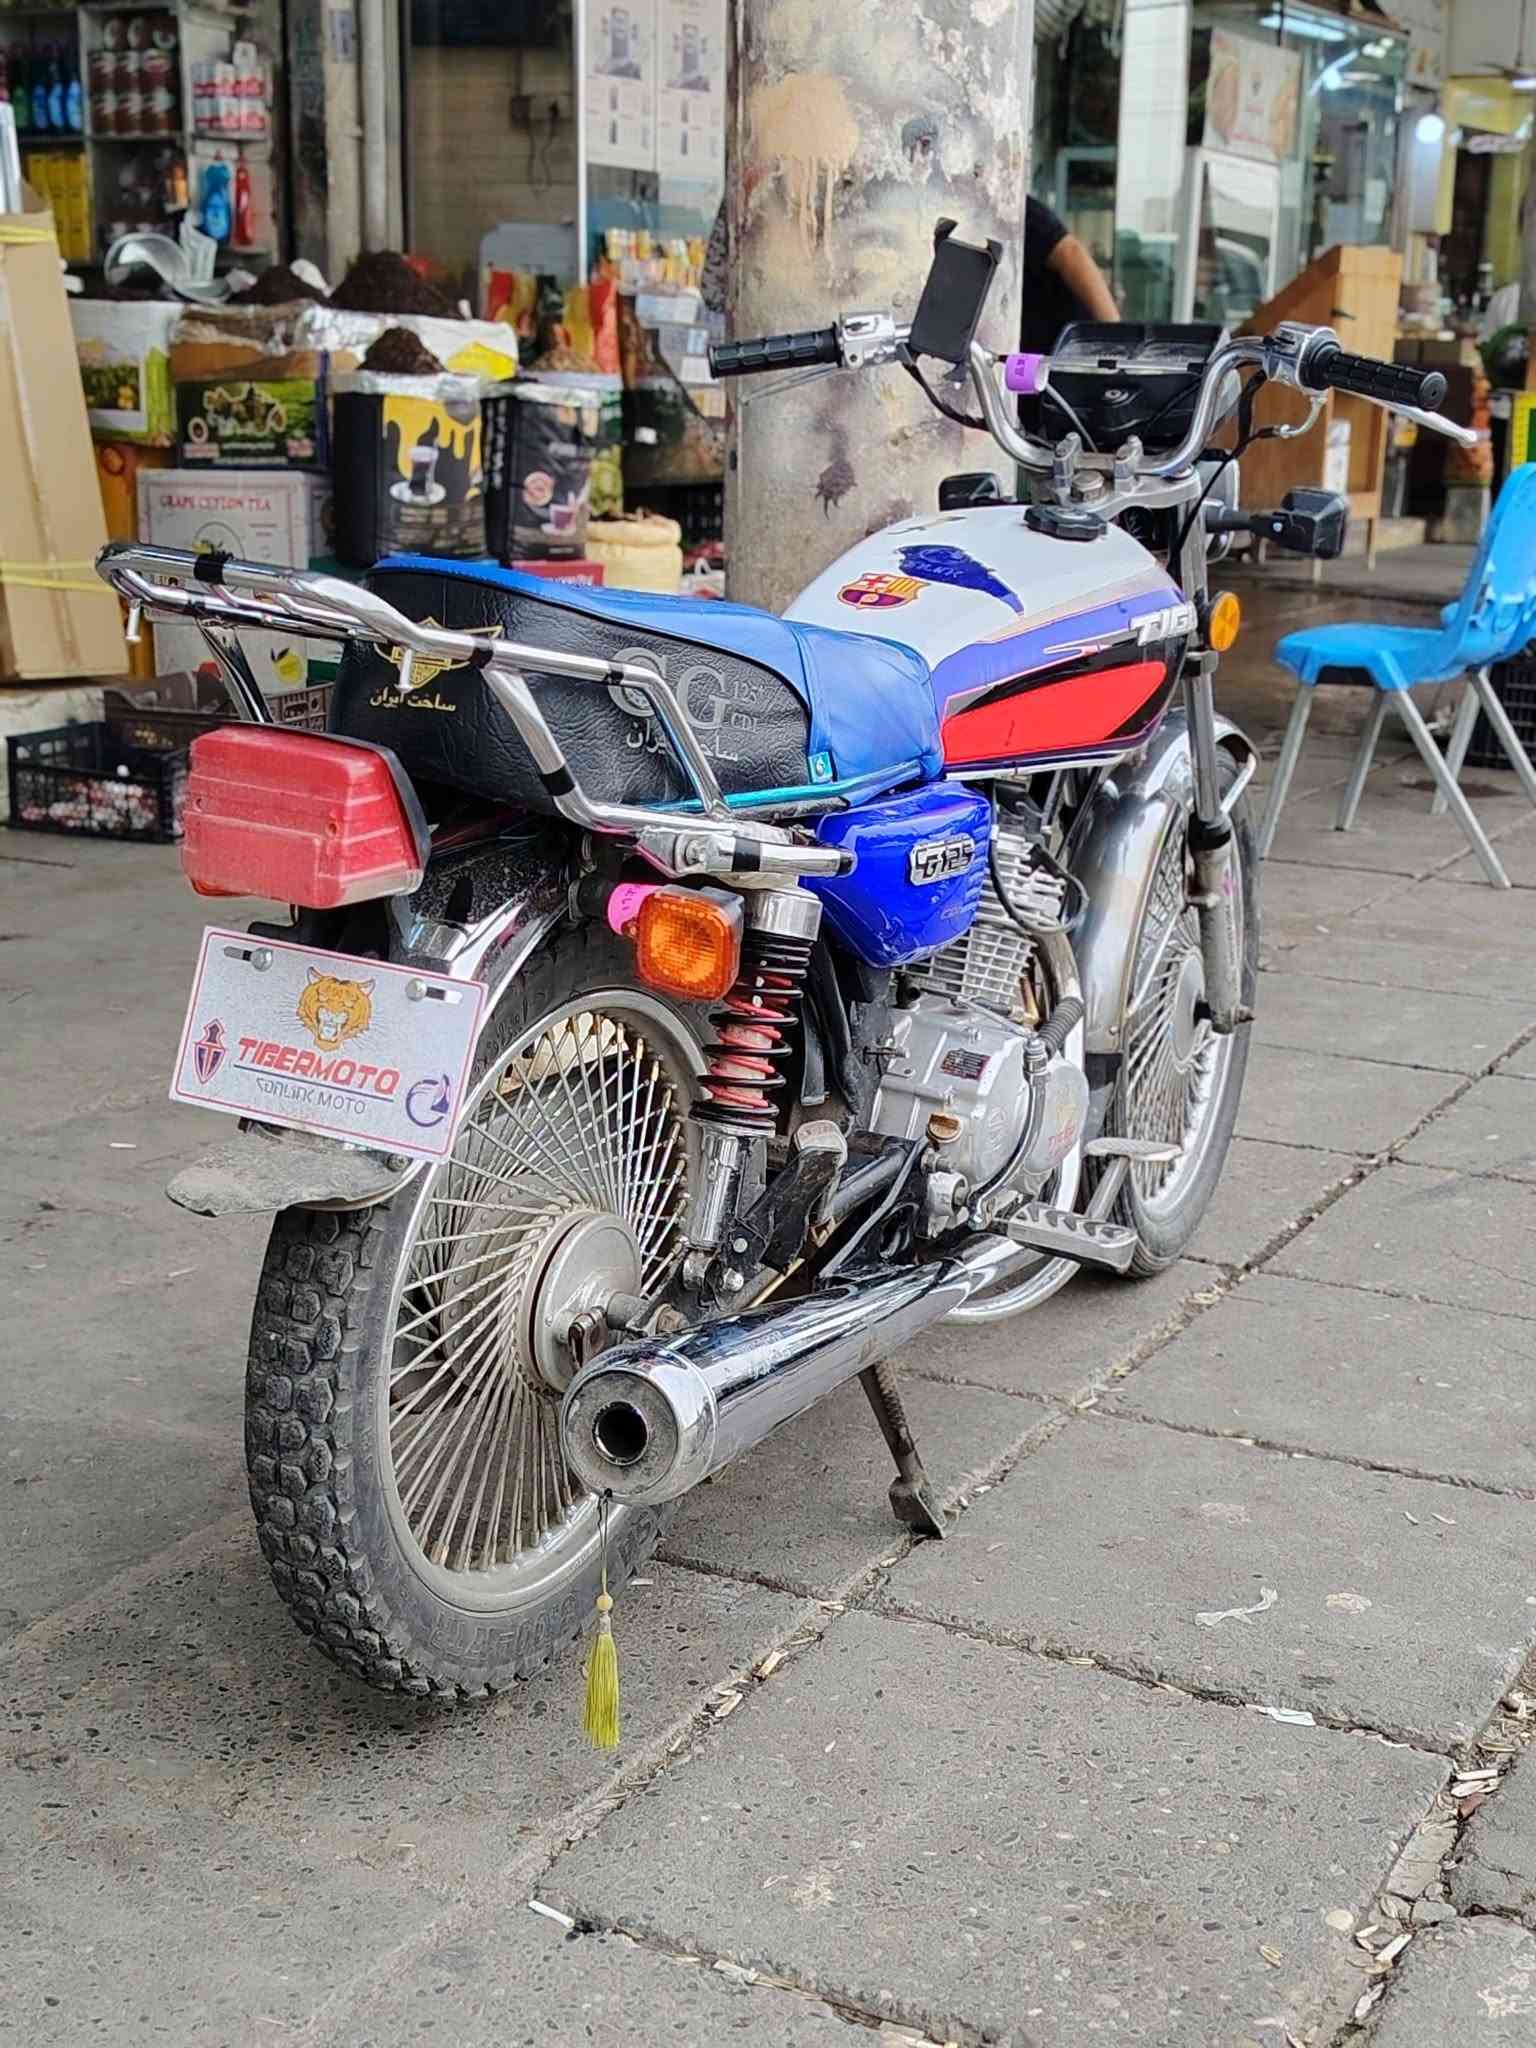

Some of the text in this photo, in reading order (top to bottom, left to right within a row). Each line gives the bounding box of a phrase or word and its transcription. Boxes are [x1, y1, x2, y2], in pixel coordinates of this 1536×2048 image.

[407, 692, 456, 711] ساخت
[238, 1037, 401, 1095] TIGERMOTO
[318, 1091, 366, 1114] MOTO
